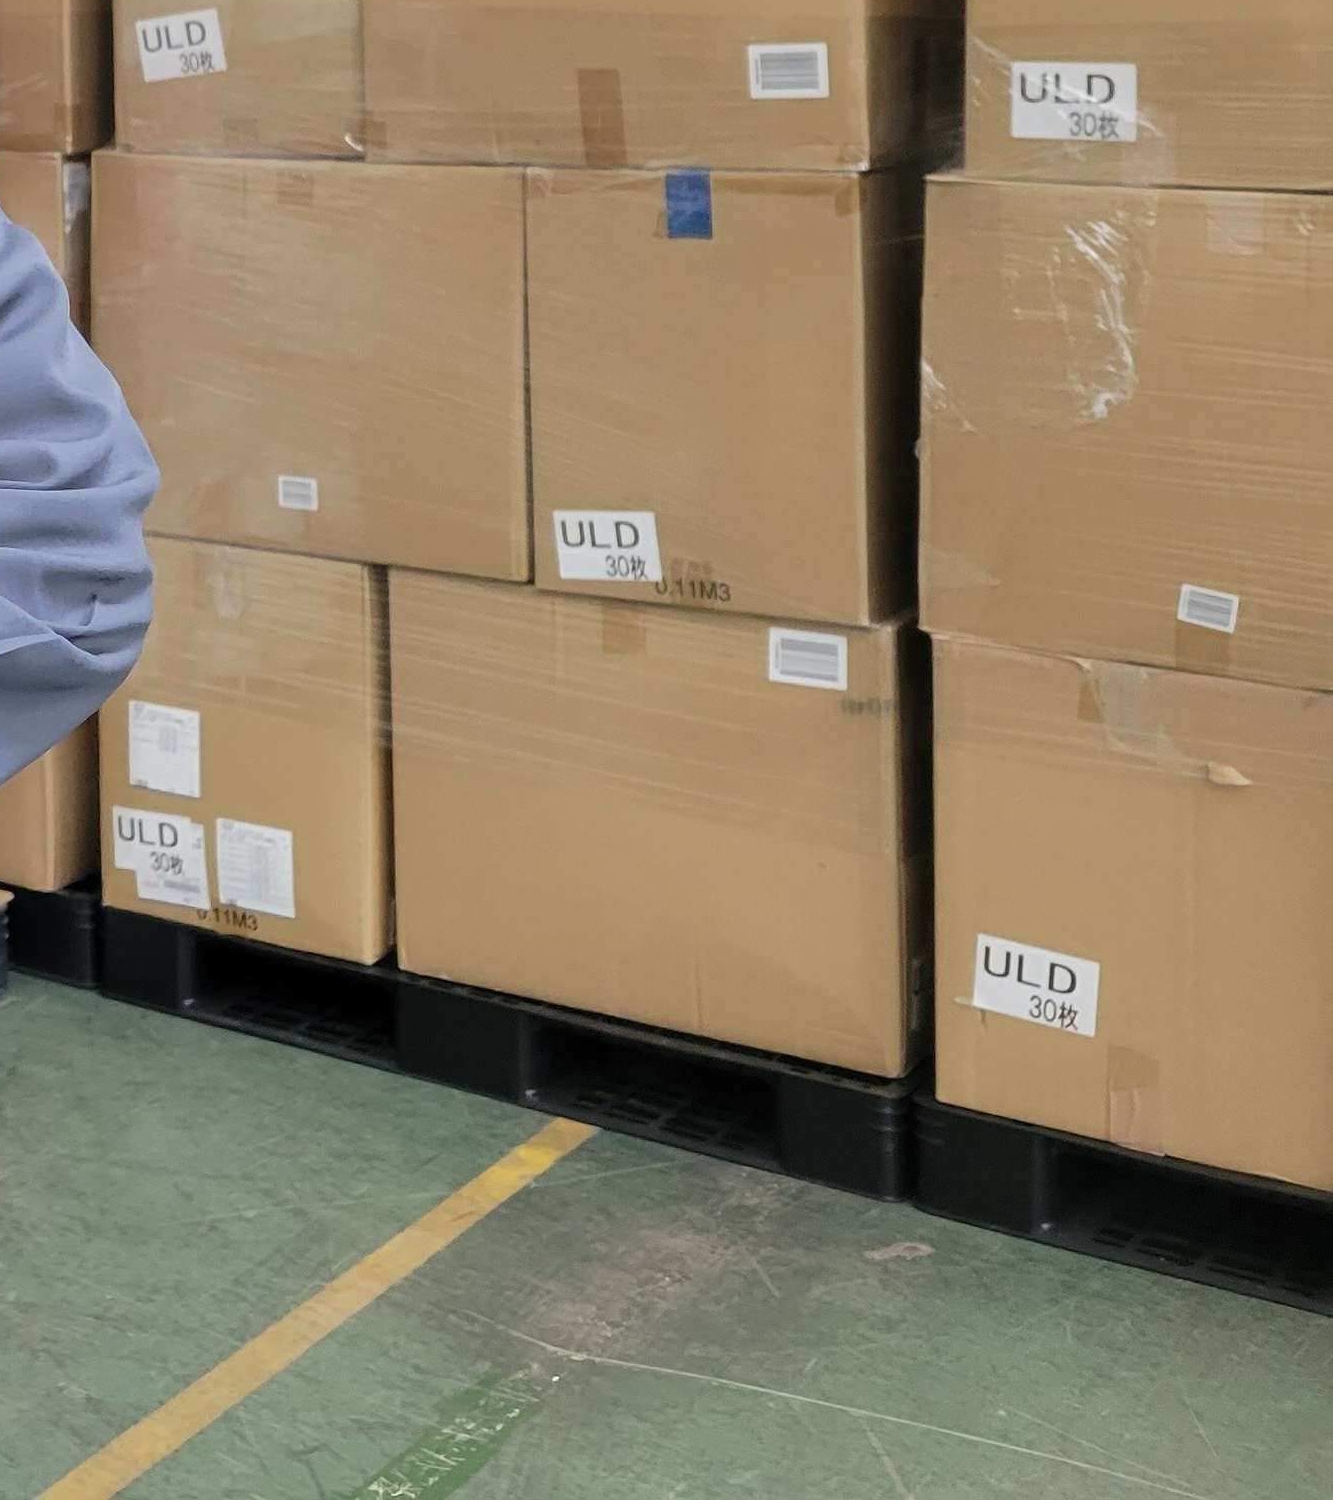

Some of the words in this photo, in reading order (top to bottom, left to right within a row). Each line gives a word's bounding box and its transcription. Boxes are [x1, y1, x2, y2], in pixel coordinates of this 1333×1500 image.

[142, 21, 206, 52] ULD
[179, 51, 215, 74] 30枚
[1020, 73, 1116, 104] ULD
[1068, 110, 1119, 140] 30枚
[561, 520, 640, 549] ULD
[605, 555, 649, 581] 30枚
[118, 815, 178, 848] ULD
[983, 945, 1077, 994] ULD
[1029, 995, 1079, 1031] 30枚
